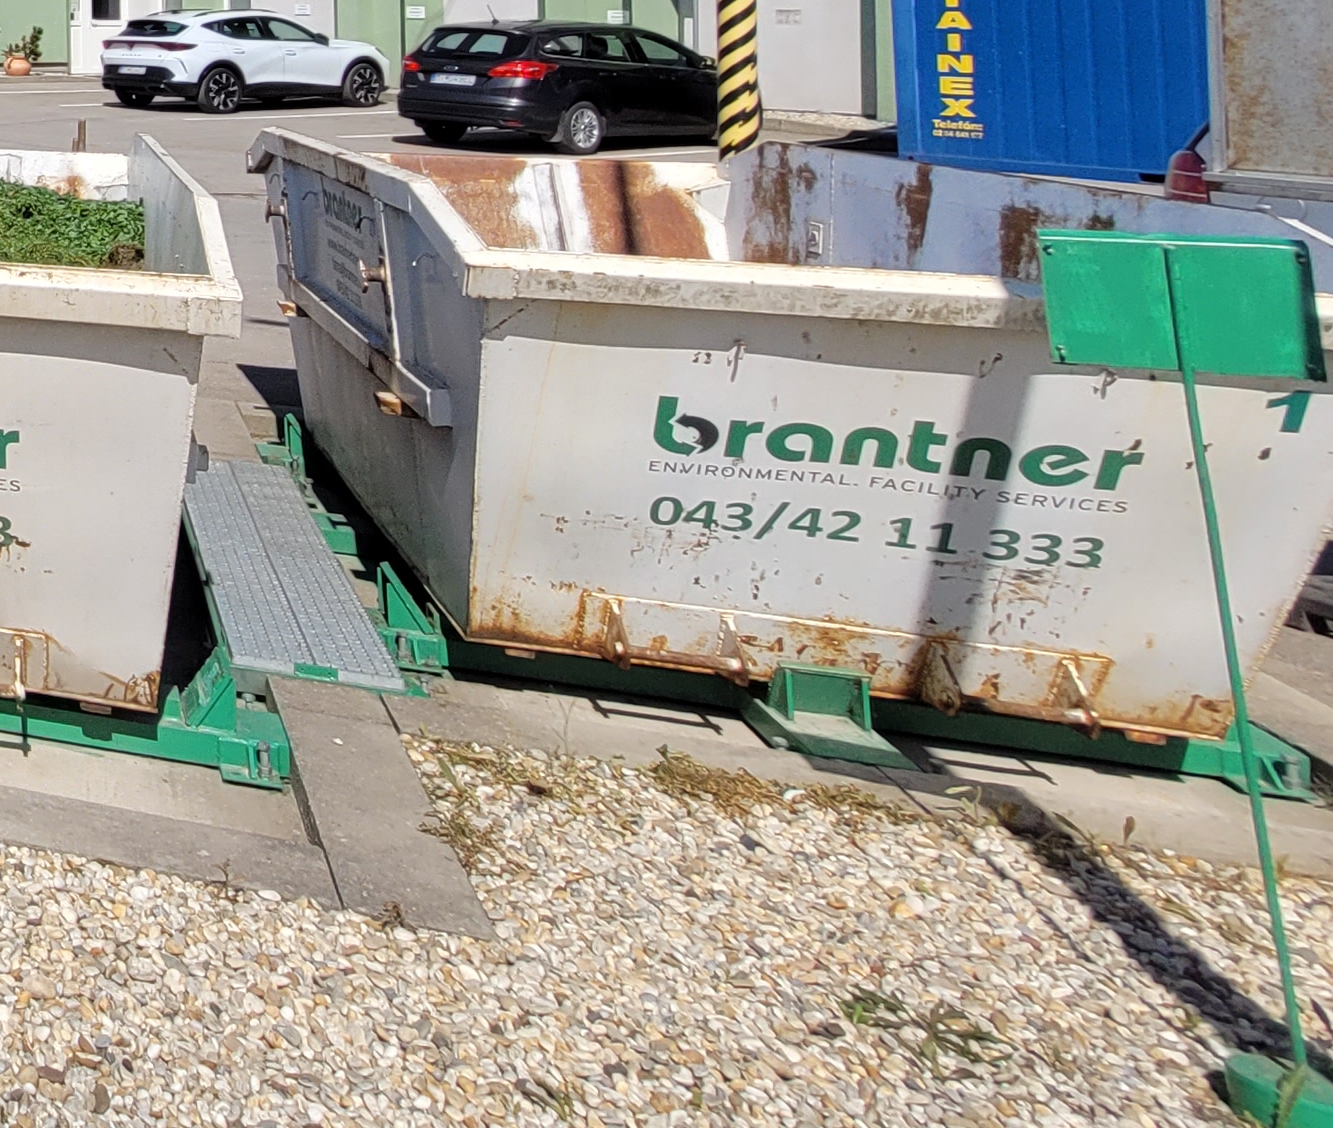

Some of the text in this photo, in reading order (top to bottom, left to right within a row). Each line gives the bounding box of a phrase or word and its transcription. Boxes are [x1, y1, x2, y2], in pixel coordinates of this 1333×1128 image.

[1266, 389, 1312, 433] 1
[653, 395, 1144, 491] brantner
[870, 476, 986, 501] FACILITY
[996, 490, 1129, 514] SERVICES
[649, 496, 1106, 569] 043/42 11 333
